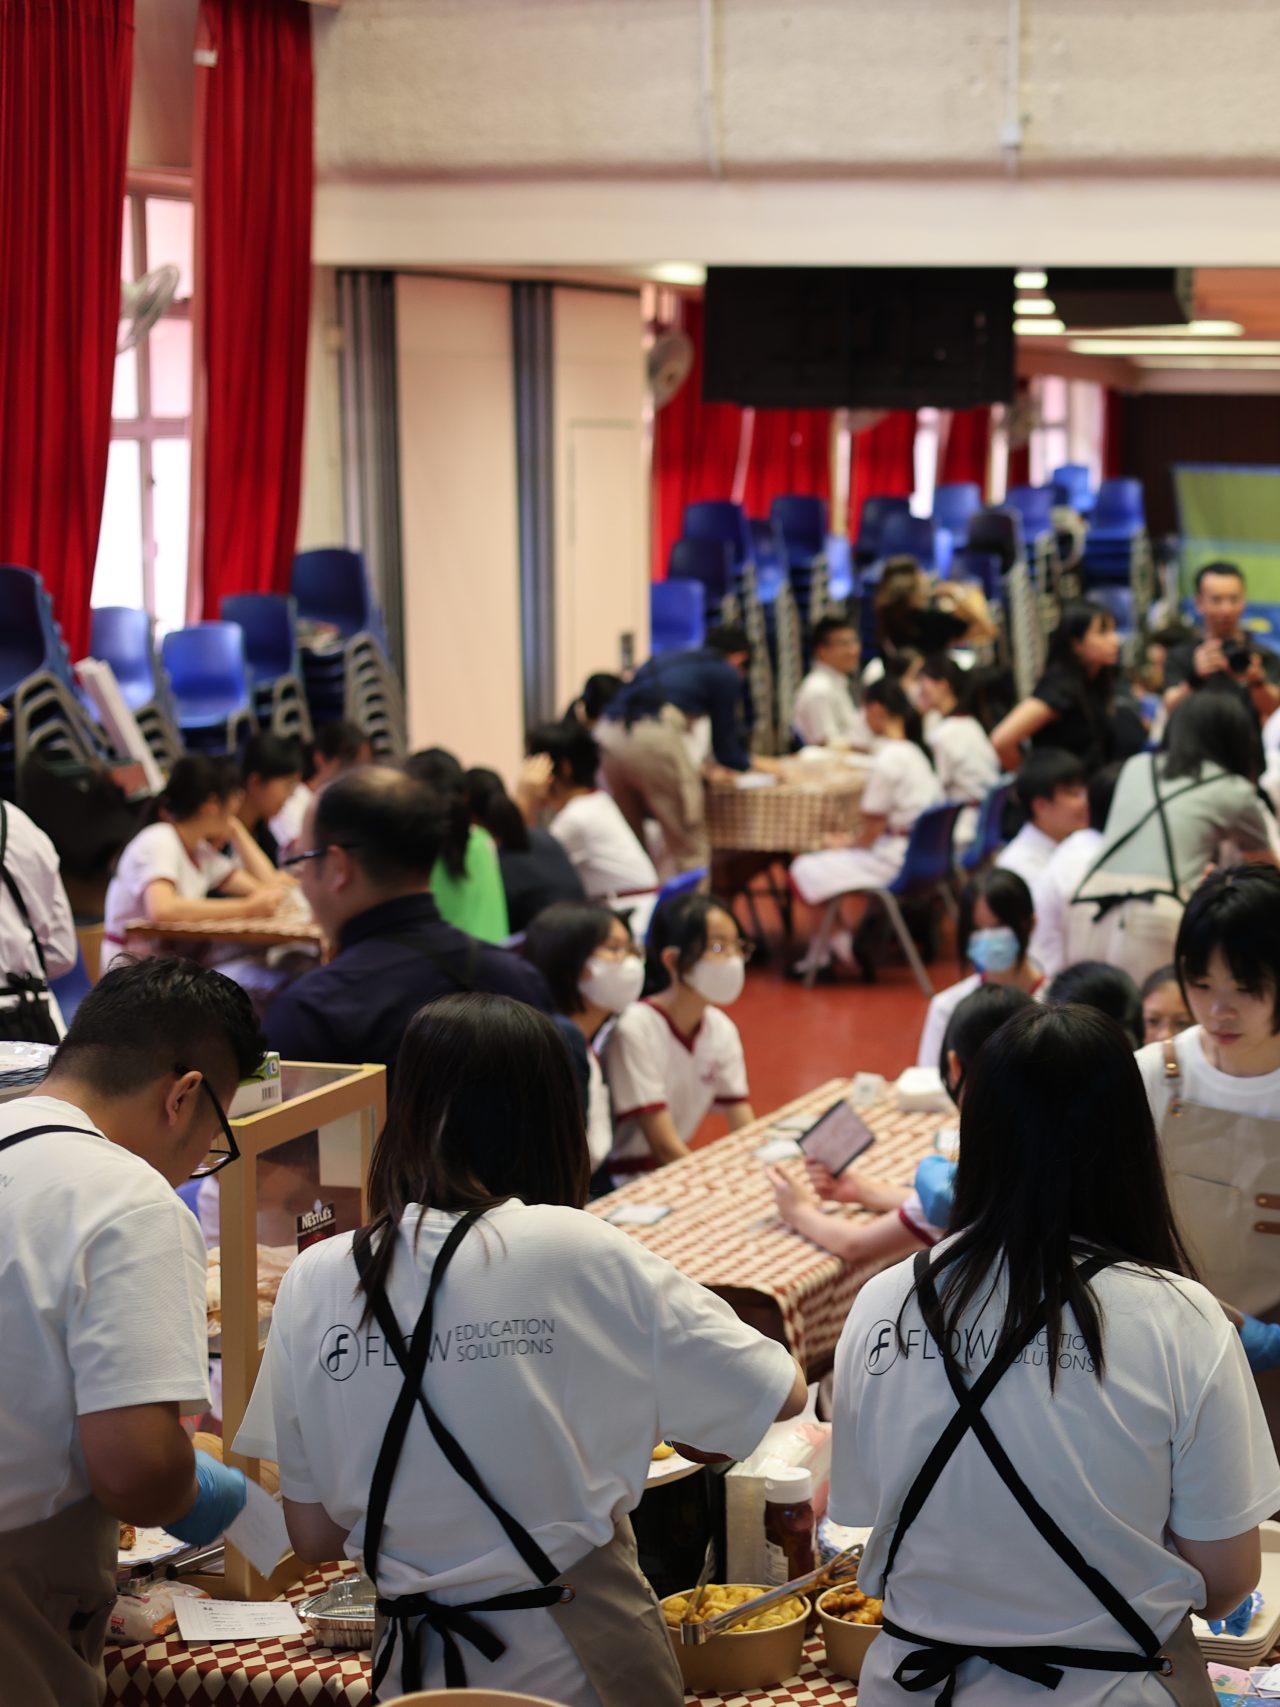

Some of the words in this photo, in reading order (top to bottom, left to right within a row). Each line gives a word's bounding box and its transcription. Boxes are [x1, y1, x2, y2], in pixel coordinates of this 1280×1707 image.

[456, 1318, 555, 1342] EDUCATION
[366, 1329, 452, 1367] FLW
[456, 1339, 554, 1362] SOLUTIONS
